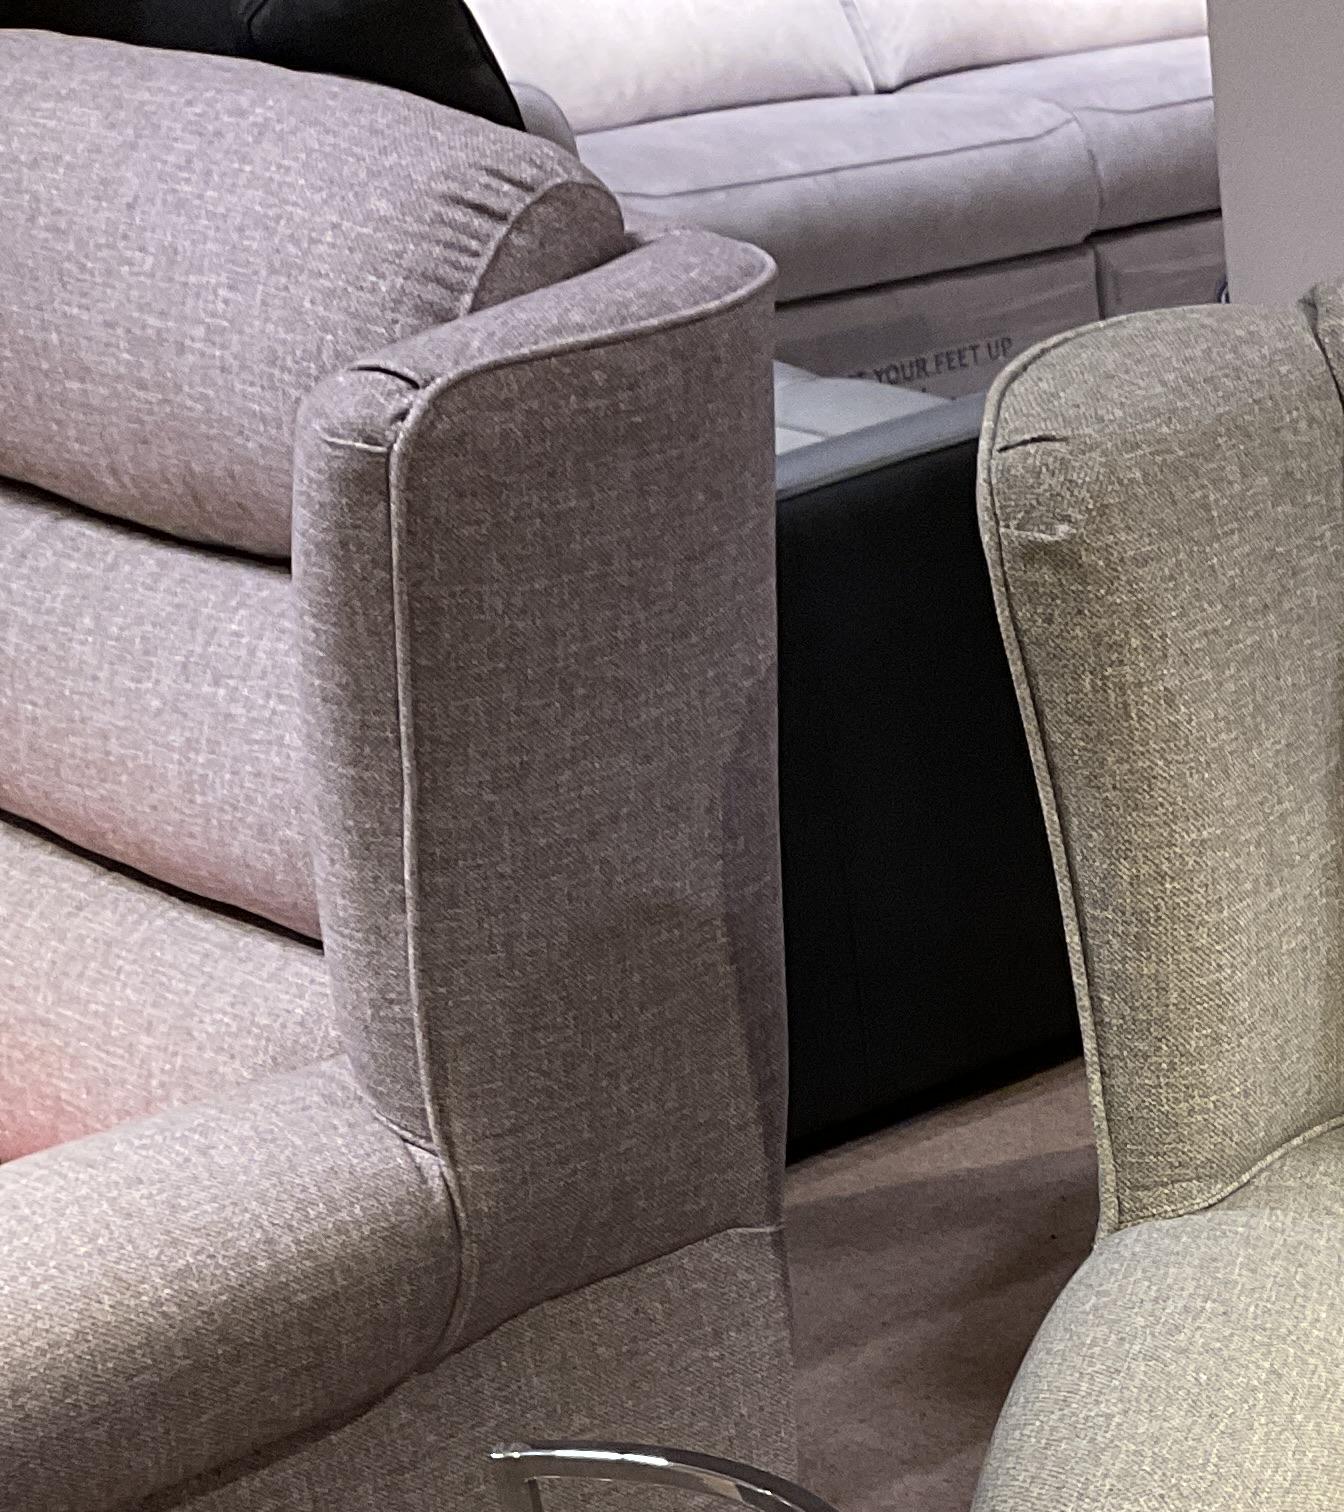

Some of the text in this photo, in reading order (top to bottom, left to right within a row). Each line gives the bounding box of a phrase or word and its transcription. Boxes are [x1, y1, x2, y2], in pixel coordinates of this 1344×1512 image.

[873, 336, 1013, 385] YOUR FEET UP
